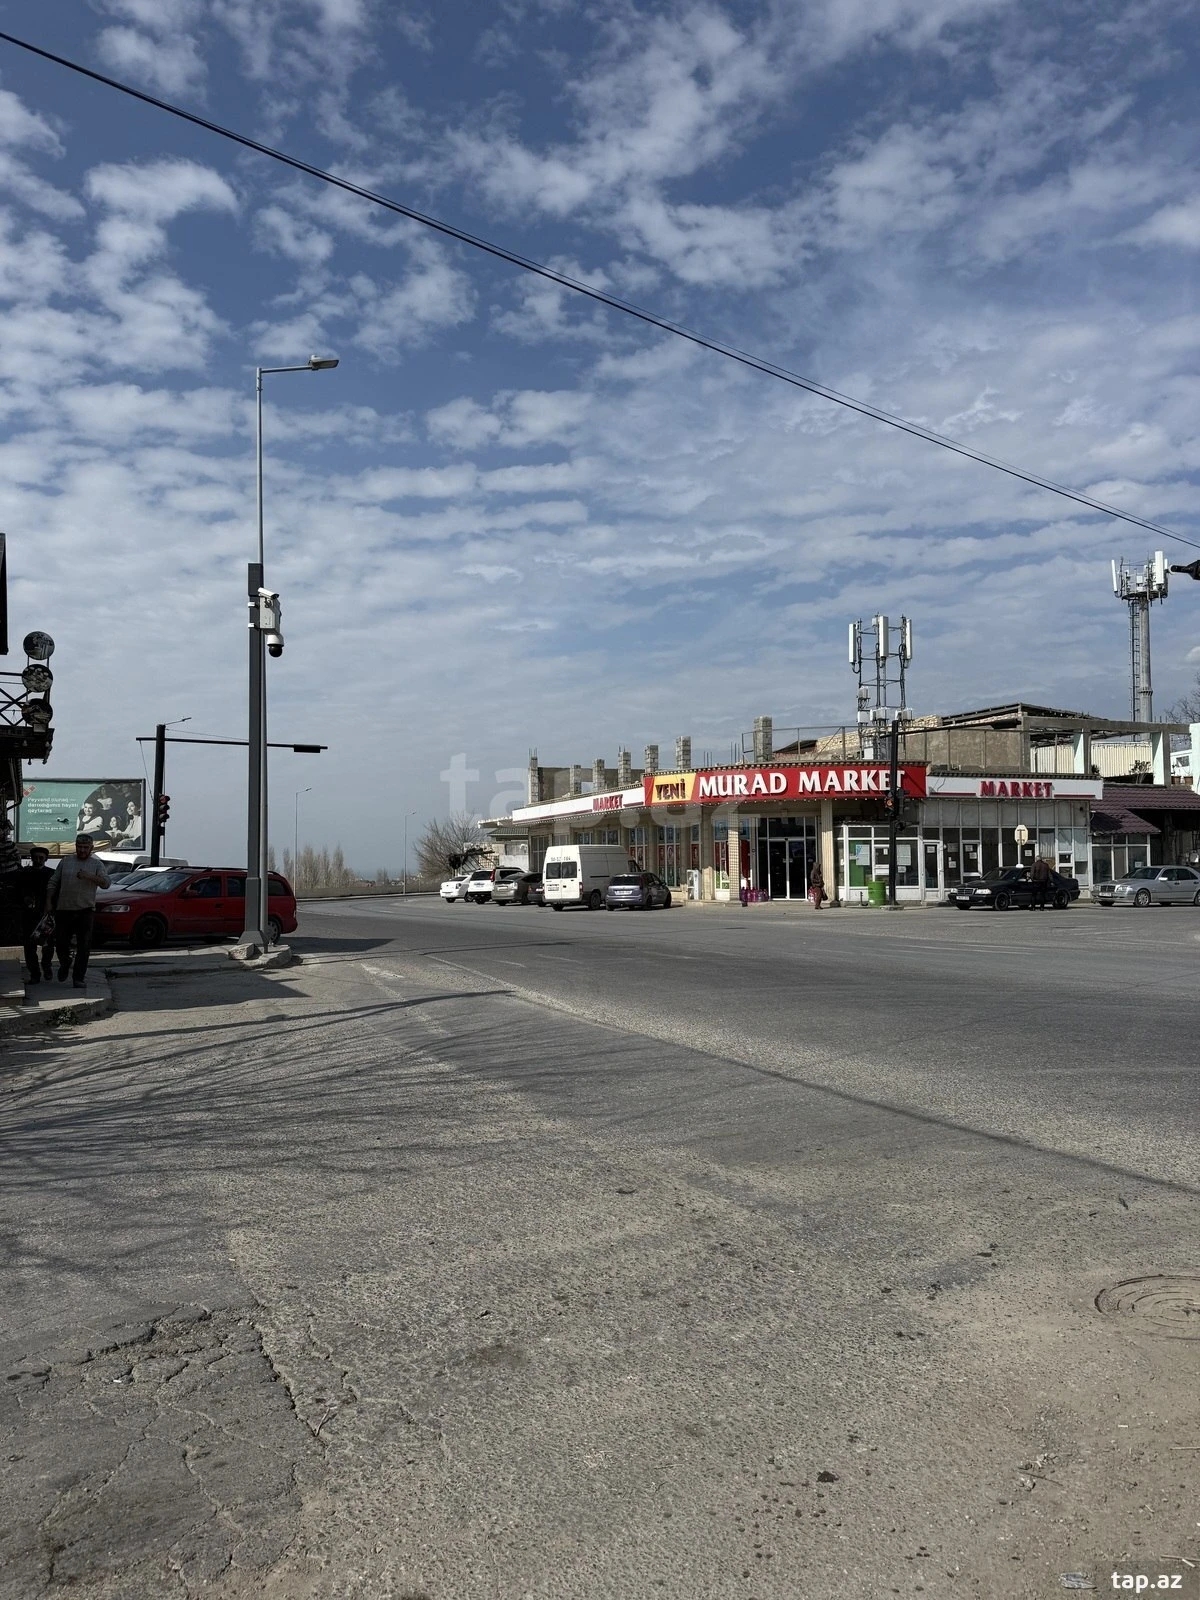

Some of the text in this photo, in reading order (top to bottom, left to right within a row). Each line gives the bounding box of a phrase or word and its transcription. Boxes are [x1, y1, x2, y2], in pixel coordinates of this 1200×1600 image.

[655, 778, 686, 800] YENİ
[698, 769, 906, 797] MURAD MARKET
[979, 780, 1053, 799] MARKET
[592, 794, 623, 811] MARKET
